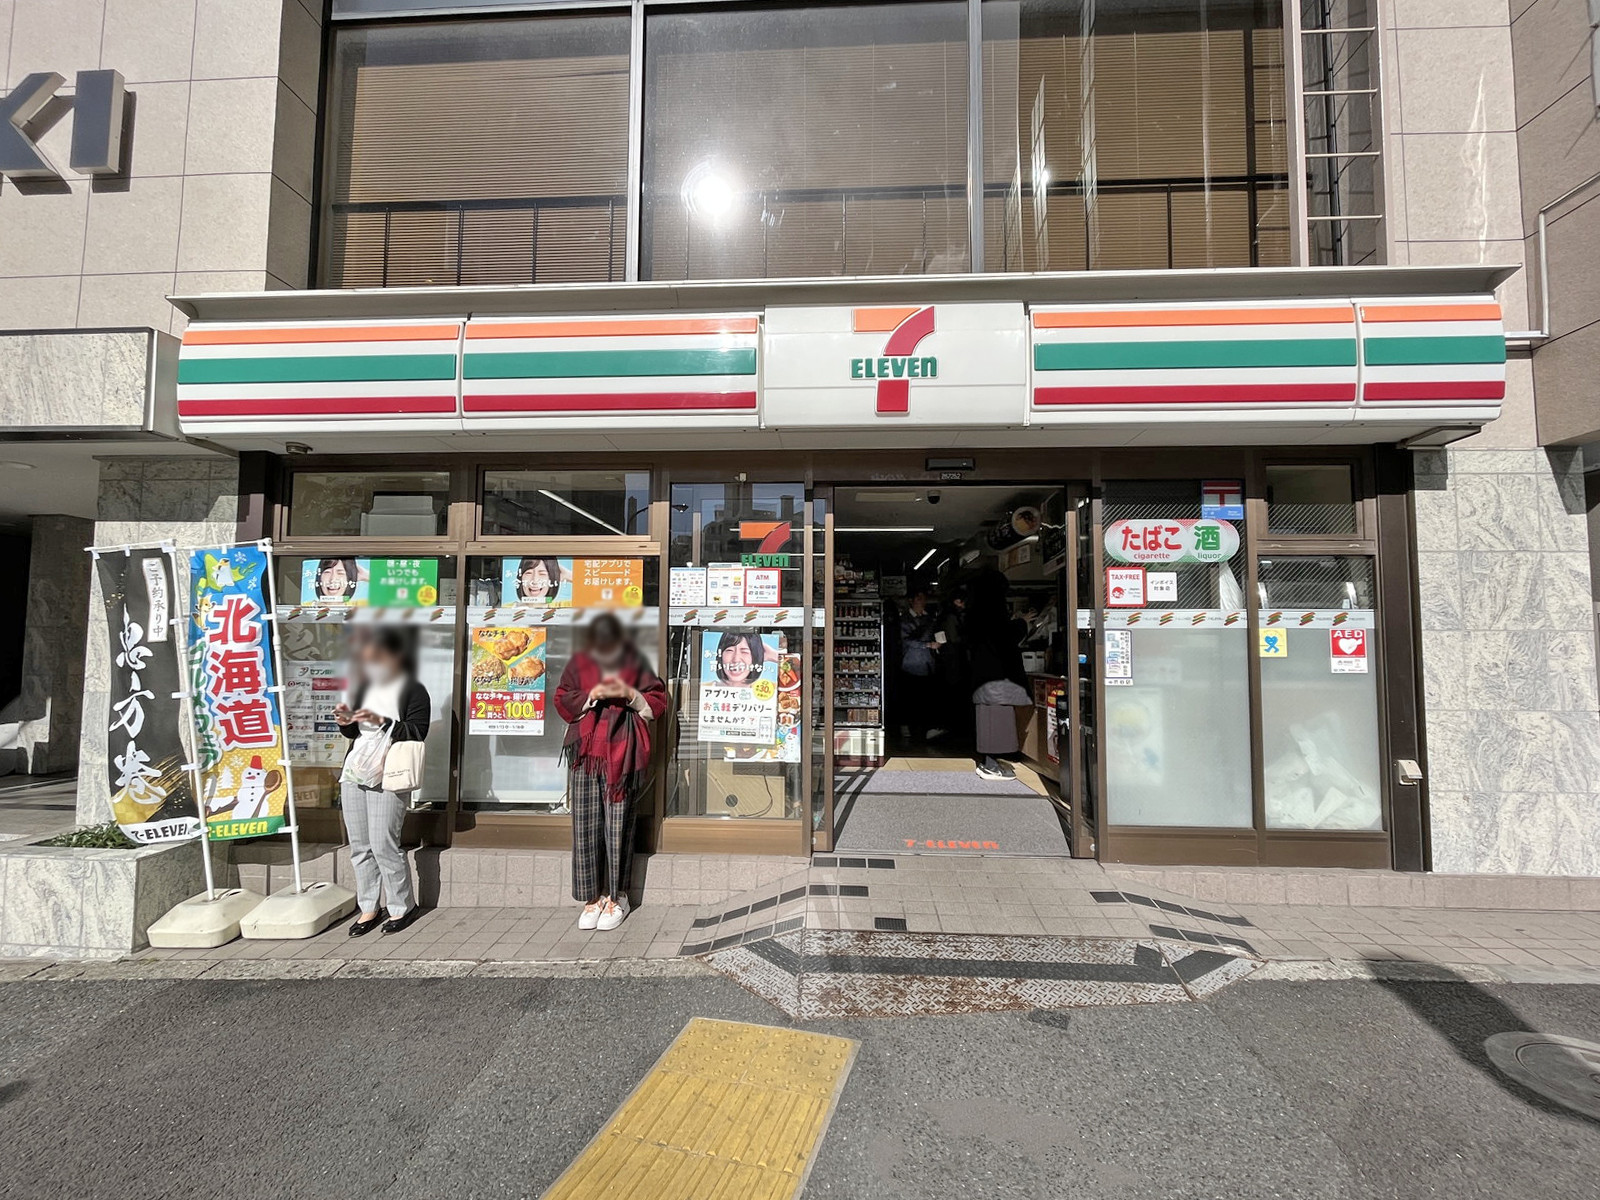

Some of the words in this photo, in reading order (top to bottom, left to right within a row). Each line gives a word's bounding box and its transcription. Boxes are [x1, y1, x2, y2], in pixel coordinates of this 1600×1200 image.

[1121, 525, 1182, 551] たばこ
[1193, 525, 1221, 551] 酒
[1133, 552, 1170, 560] cigarette
[1197, 552, 1222, 560] liquor
[147, 561, 165, 637] ご予約承り中
[478, 630, 507, 638] ななチキ
[1333, 630, 1363, 638] AED
[209, 598, 274, 746] 北海道
[704, 689, 739, 699] アプリで
[109, 602, 167, 804] 恵方巻
[703, 702, 772, 713] お気軽デリバリー
